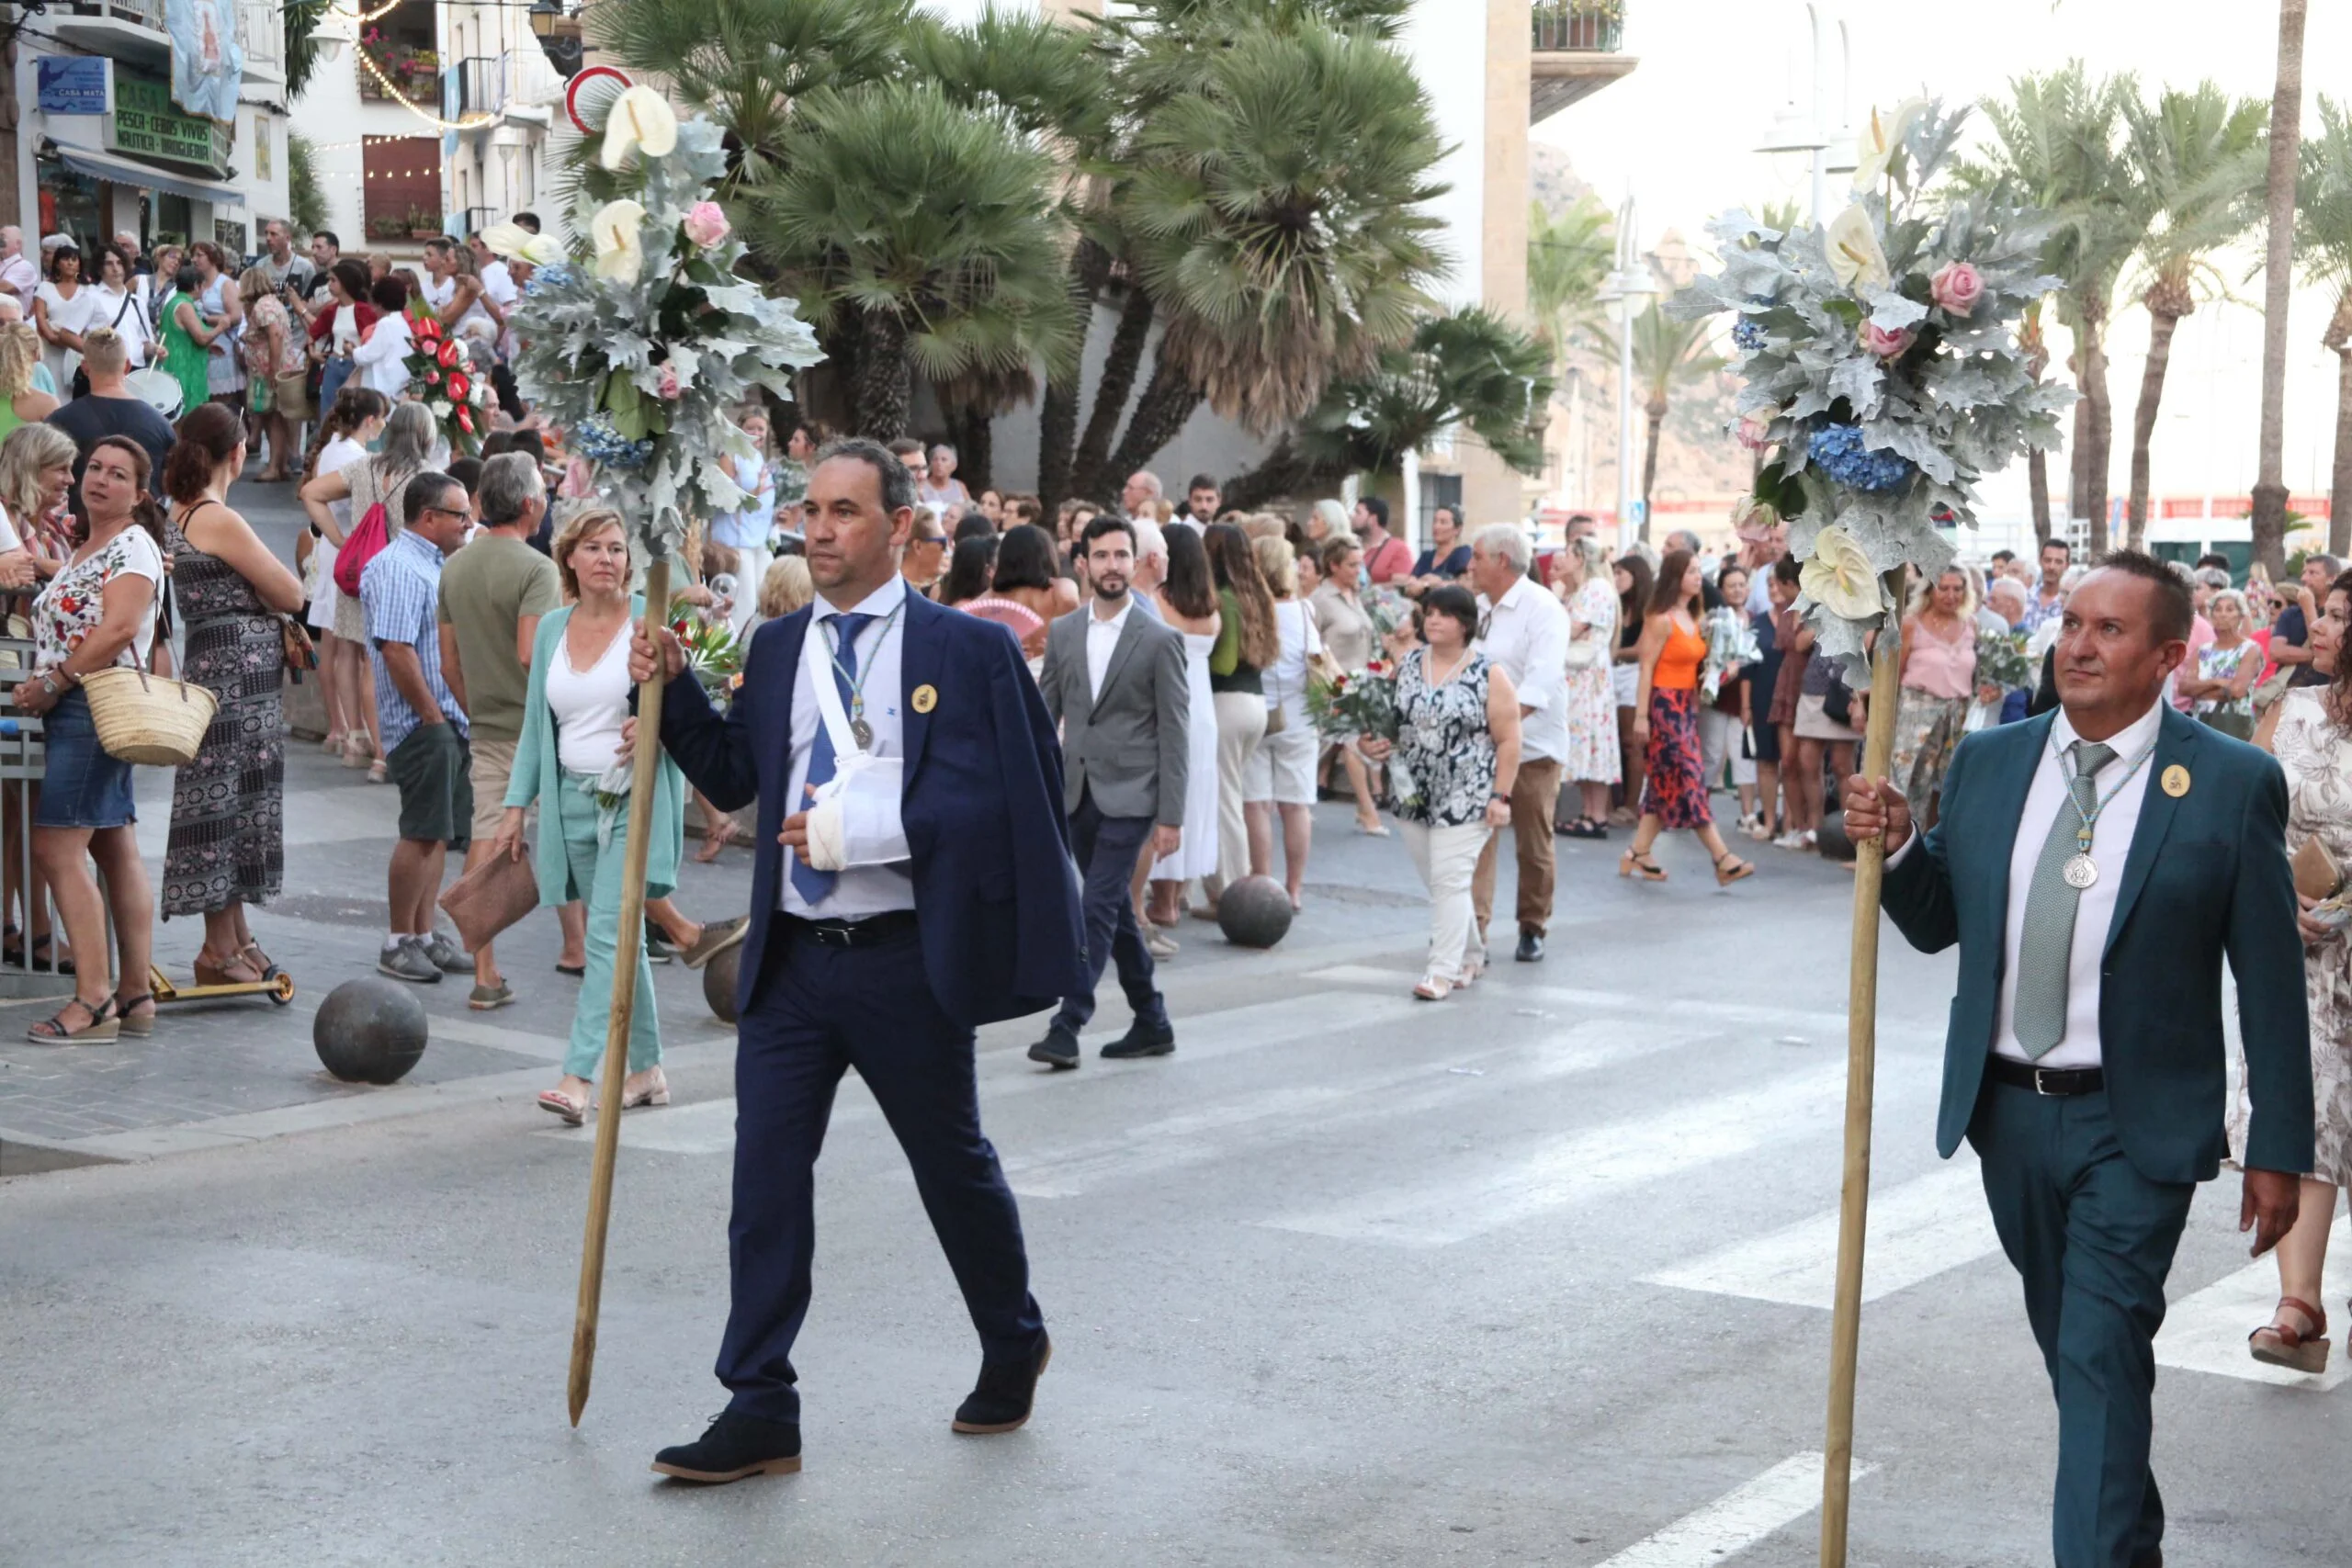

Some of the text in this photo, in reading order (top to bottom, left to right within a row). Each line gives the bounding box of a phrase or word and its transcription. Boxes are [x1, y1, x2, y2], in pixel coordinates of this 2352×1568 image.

[117, 109, 208, 141] PESCA CEBOS VIVOS
[117, 130, 209, 161] NAUTICA DROGUERIA
